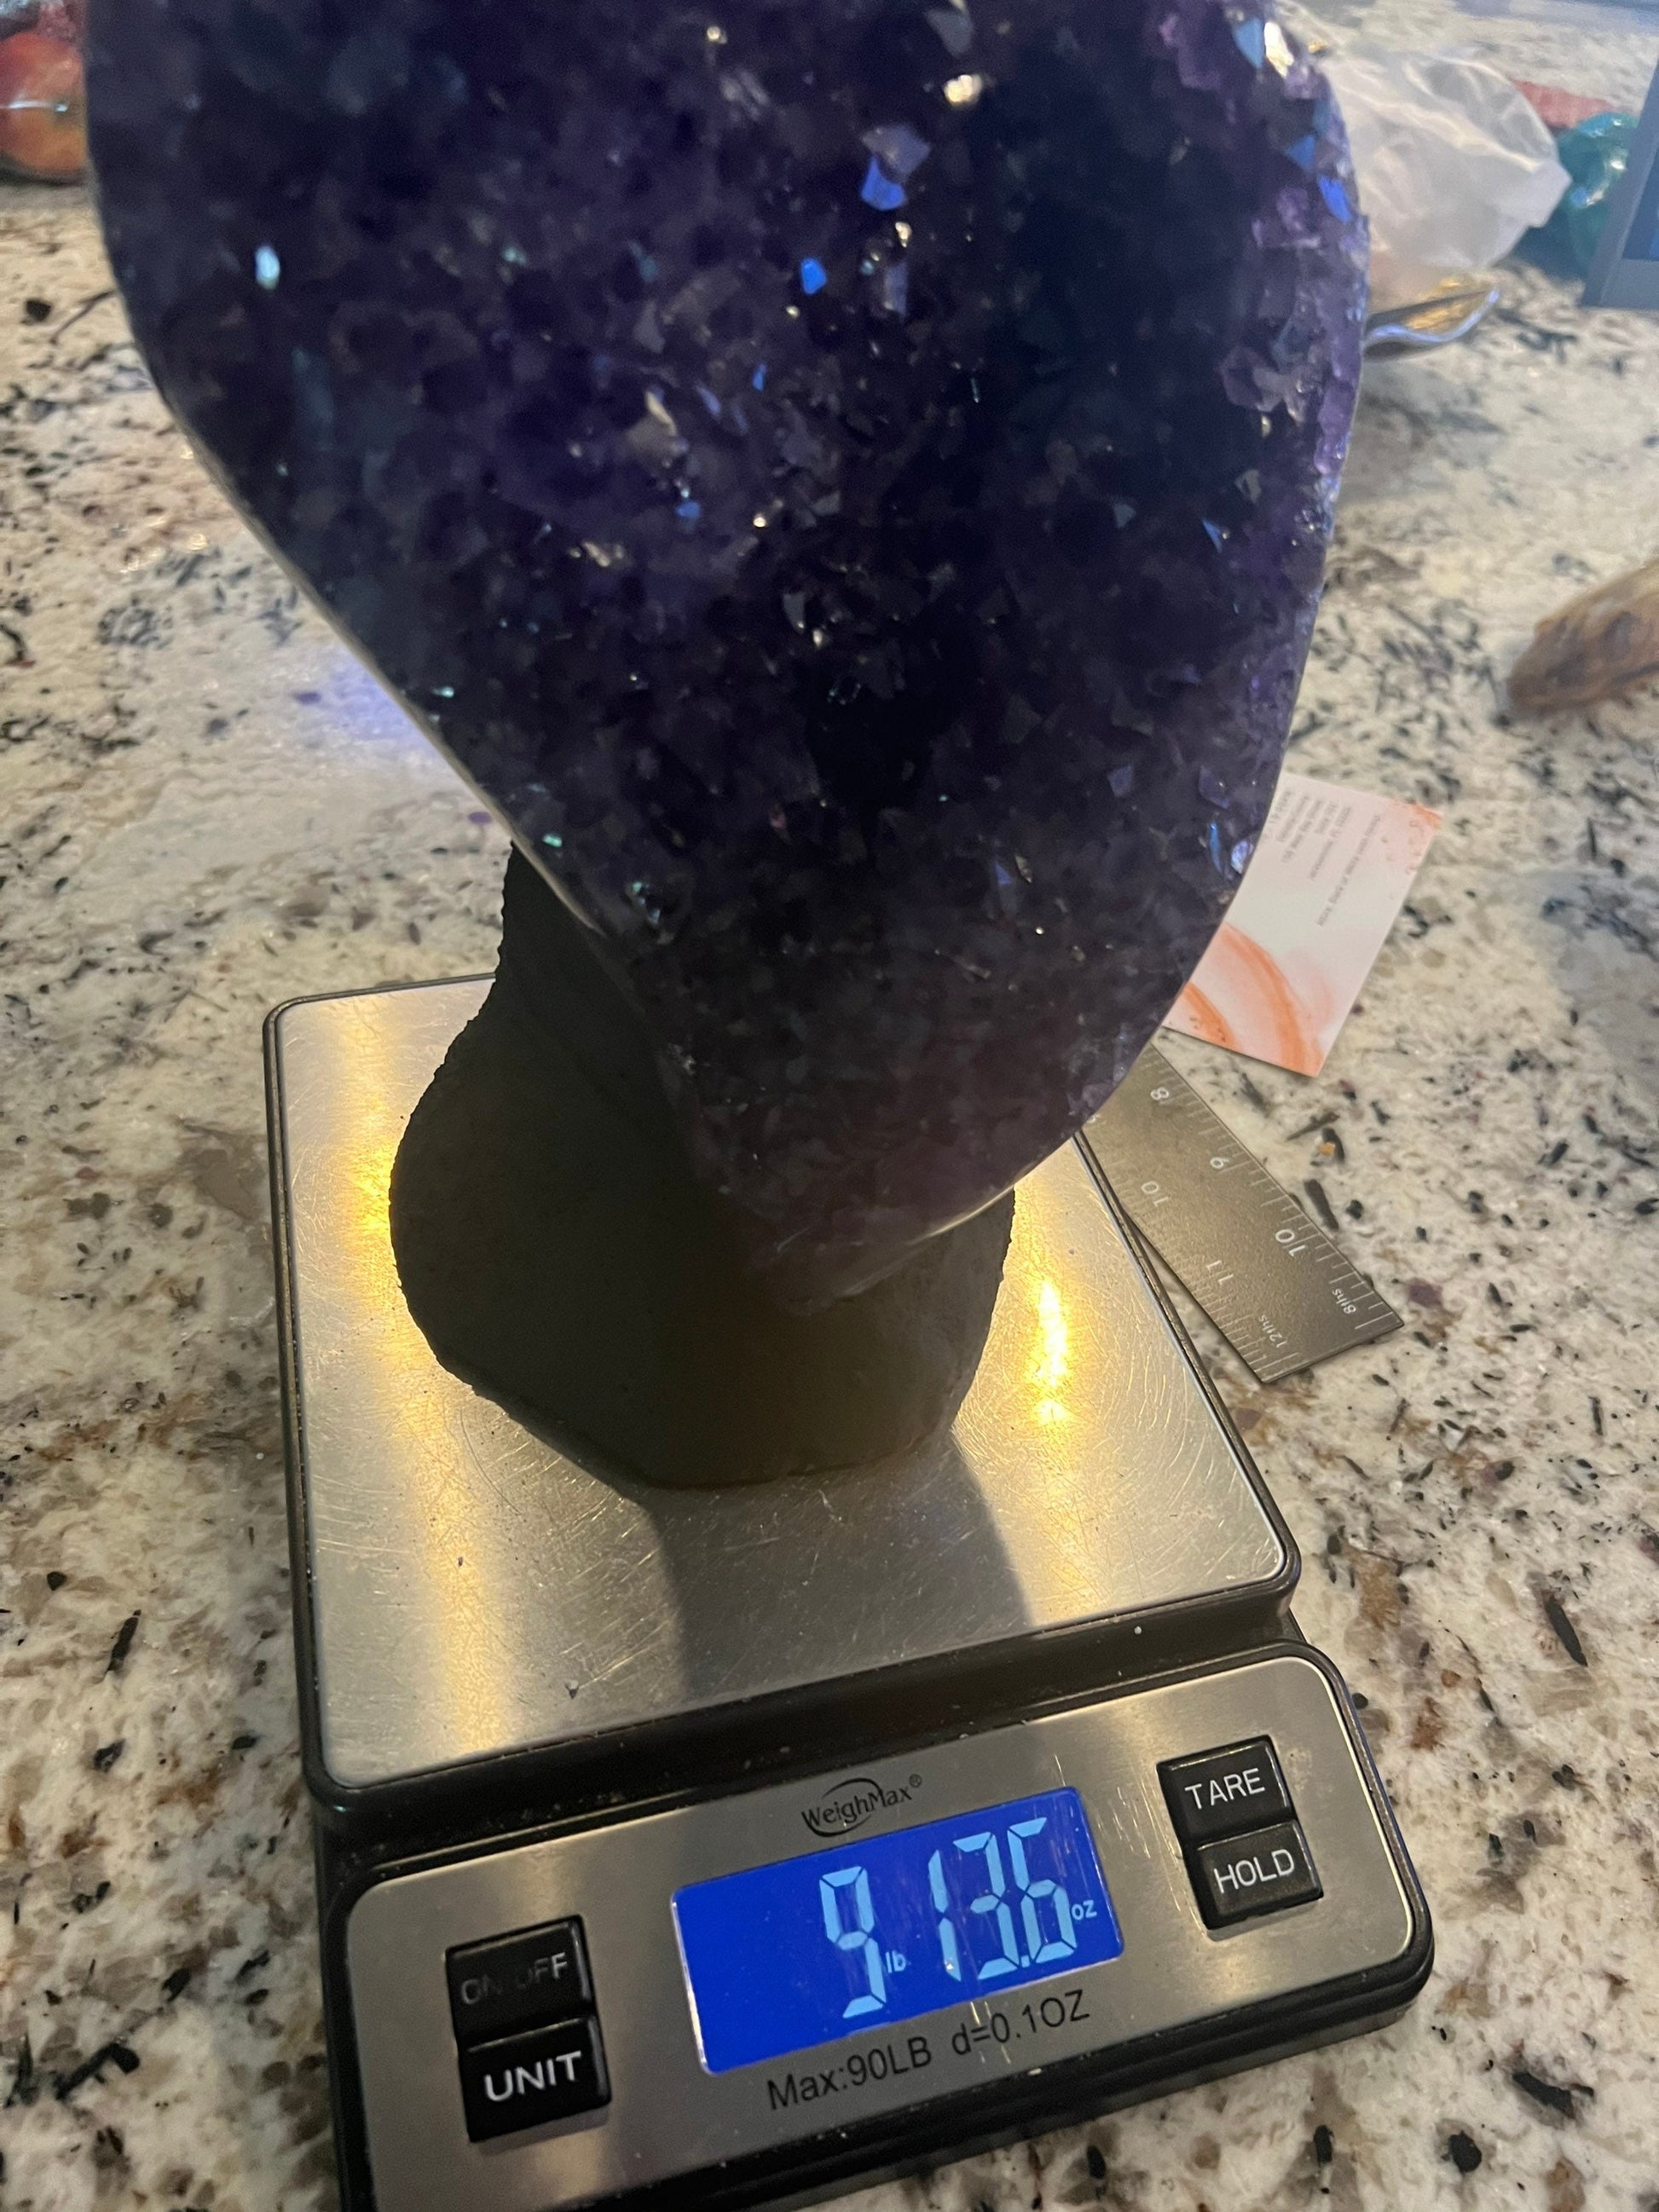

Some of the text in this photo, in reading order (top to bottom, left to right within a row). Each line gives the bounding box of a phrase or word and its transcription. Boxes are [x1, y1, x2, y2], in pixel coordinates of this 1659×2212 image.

[1150, 1087, 1170, 1101] 8
[1141, 1180, 1170, 1208] 10
[1274, 1227, 1306, 1257] 10
[1205, 1259, 1234, 1285] 11
[1331, 1287, 1357, 1315] 8ths
[1184, 1767, 1266, 1810] TARE
[1213, 1848, 1295, 1894] HOLD
[819, 1866, 887, 2019] 9
[887, 1951, 906, 1973] lb
[928, 1816, 1078, 1982] 13.6
[767, 1990, 1091, 2110] Max:90LB d=0.1OZ
[483, 2050, 582, 2102] UNIT
